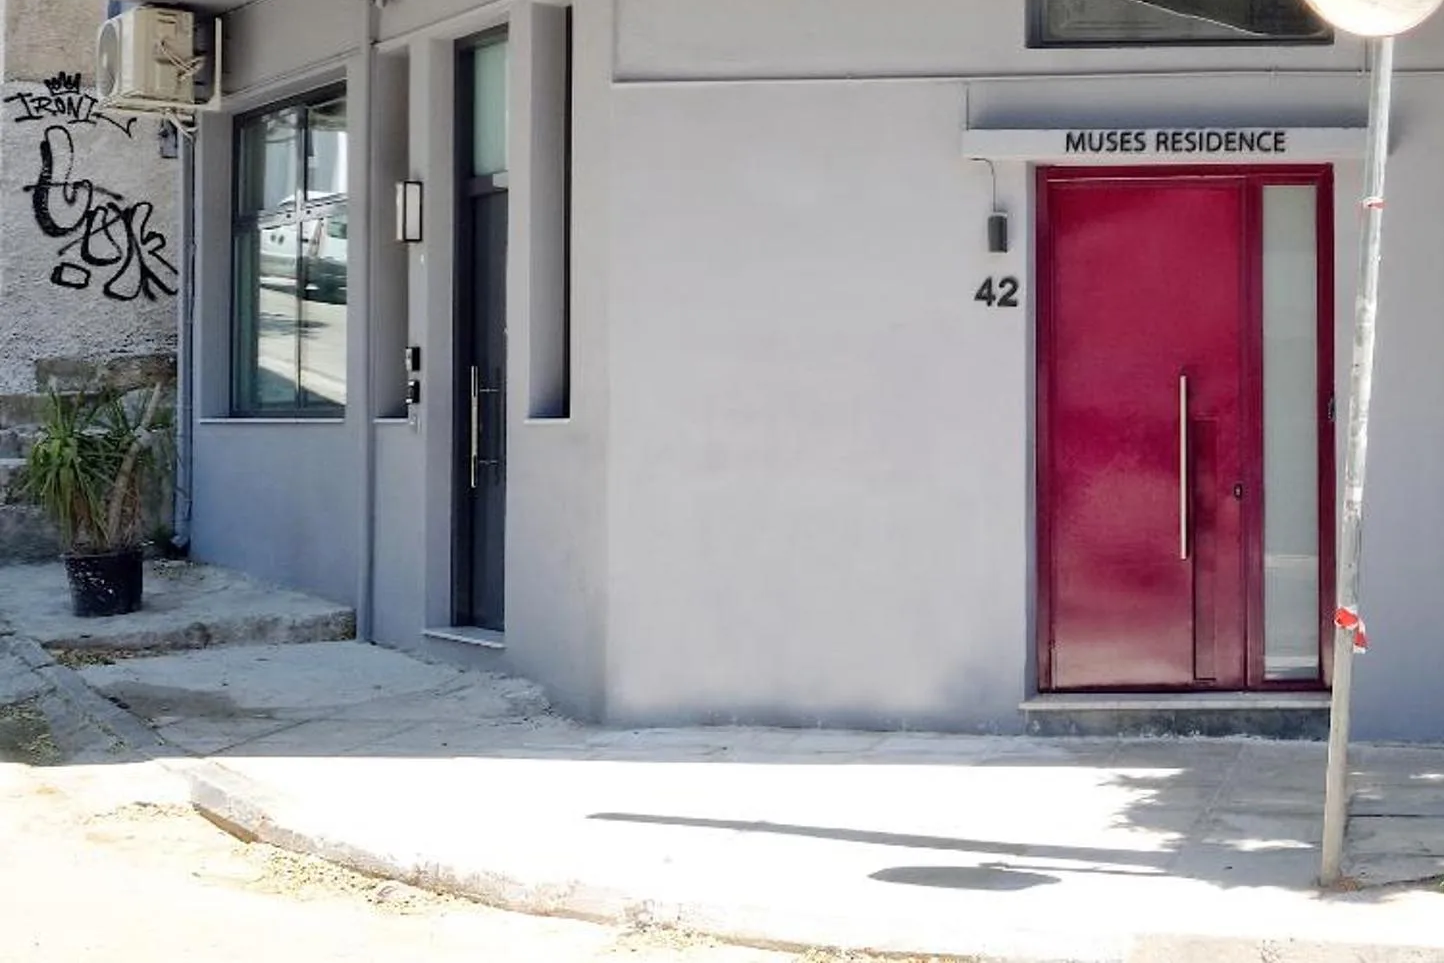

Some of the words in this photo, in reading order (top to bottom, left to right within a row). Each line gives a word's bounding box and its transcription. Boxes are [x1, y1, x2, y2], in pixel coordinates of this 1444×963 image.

[1065, 132, 1146, 153] MUSES
[1156, 131, 1286, 153] RESIDENCE
[974, 277, 1019, 308] 42
